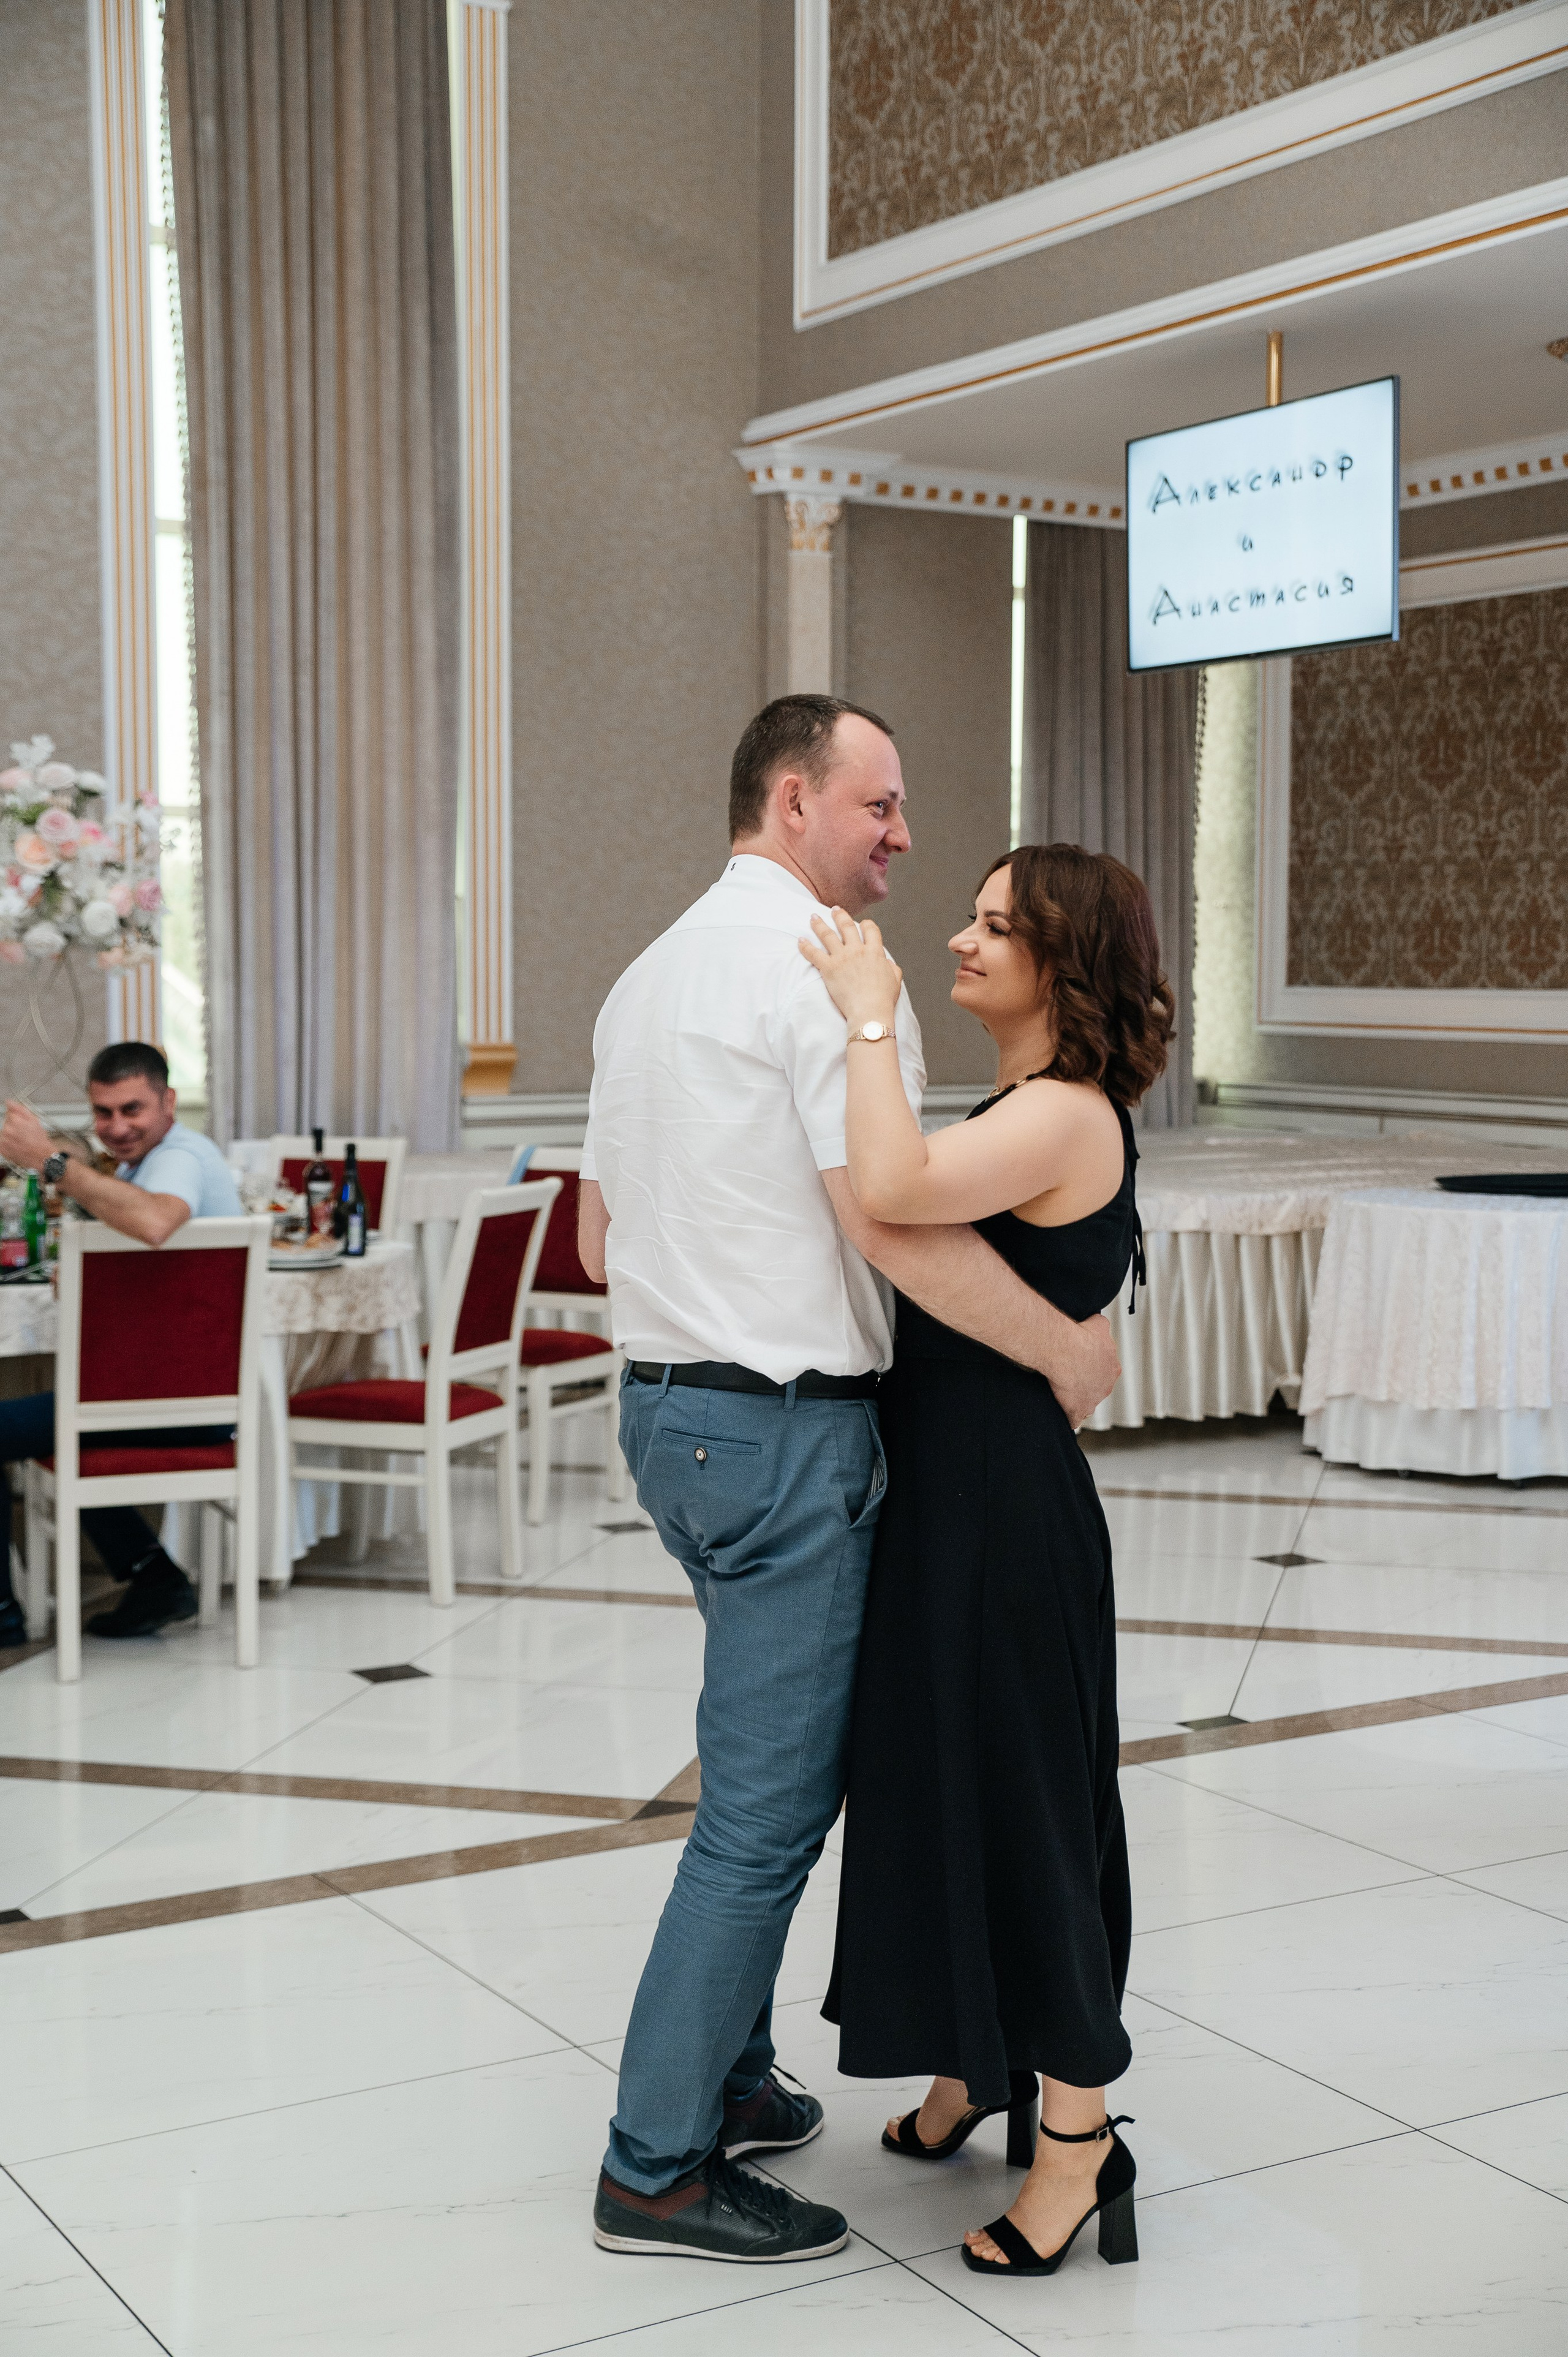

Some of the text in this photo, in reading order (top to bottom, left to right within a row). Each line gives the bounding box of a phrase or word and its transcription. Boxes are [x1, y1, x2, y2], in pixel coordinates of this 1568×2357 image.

[1152, 455, 1354, 513] Александр
[1241, 534, 1253, 551] и
[1152, 576, 1354, 626] Анастасия
